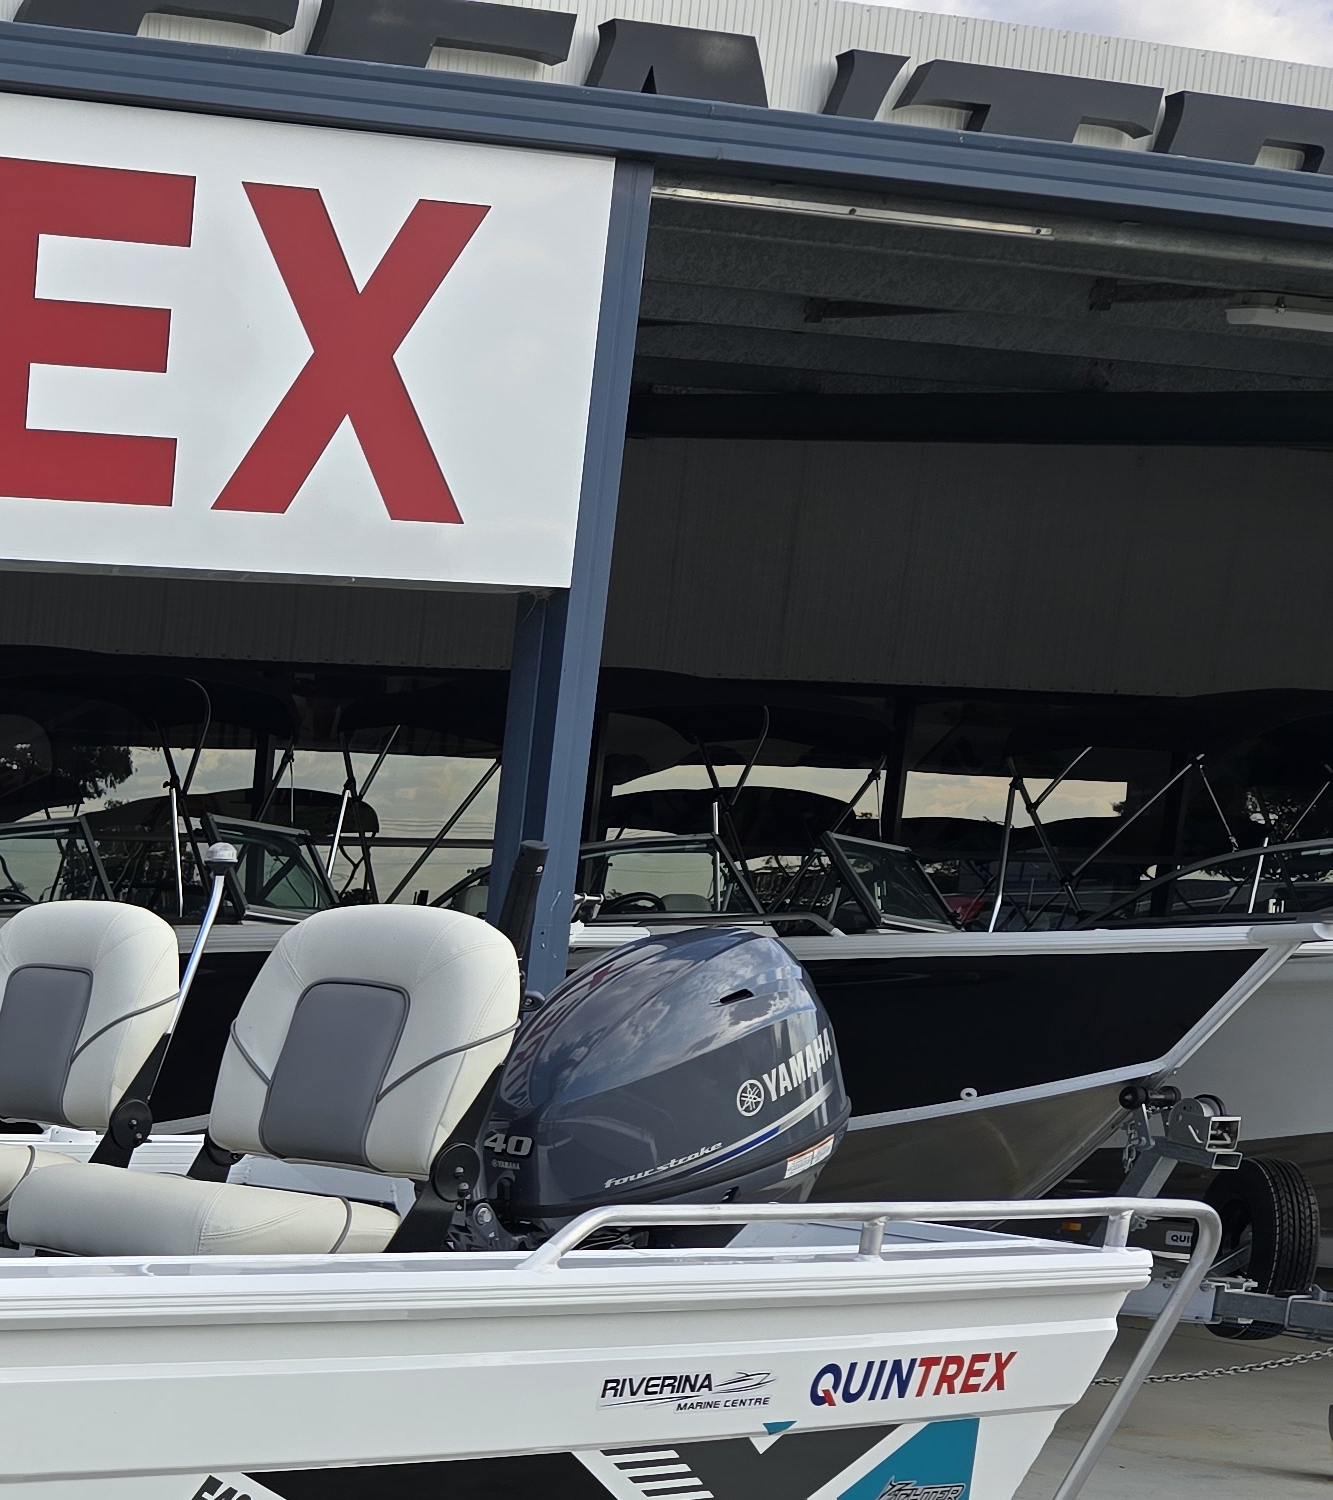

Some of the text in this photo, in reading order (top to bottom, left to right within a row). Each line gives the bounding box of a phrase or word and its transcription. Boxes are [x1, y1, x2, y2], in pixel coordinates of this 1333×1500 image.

[762, 1027, 833, 1102] YAMAHA
[483, 1133, 533, 1156] 40
[600, 1373, 714, 1399] RIVERINA
[810, 1351, 1018, 1407] QUINTREX
[676, 1397, 770, 1412] MARINE CENTRE
